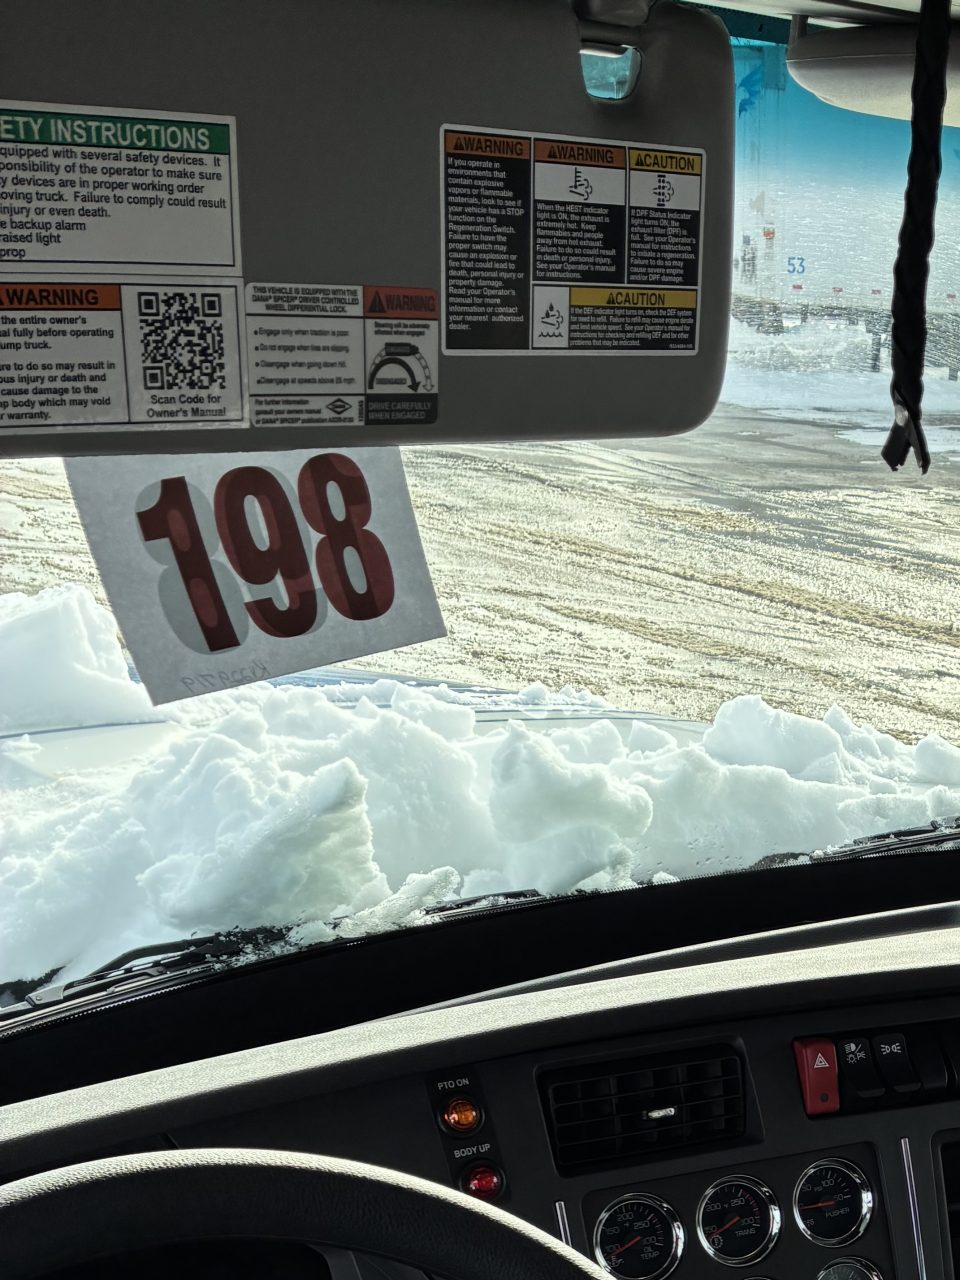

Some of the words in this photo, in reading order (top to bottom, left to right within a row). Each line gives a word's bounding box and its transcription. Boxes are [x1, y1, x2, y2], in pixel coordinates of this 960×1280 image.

[0, 115, 43, 140] ETY
[51, 118, 210, 150] INSTRUCTIONS
[464, 137, 524, 156] WARNING
[0, 145, 49, 160] quipped
[52, 147, 77, 159] with
[81, 149, 122, 161] several
[126, 152, 159, 166] safety
[162, 153, 207, 166] devices.
[213, 156, 221, 166] It
[556, 145, 614, 164] WARNING
[643, 153, 695, 171] CAUTION
[64, 162, 76, 173] of
[79, 163, 97, 175] the
[101, 166, 149, 177] operator
[152, 168, 163, 178] to
[166, 168, 195, 179] make
[199, 171, 222, 181] sure
[11, 175, 56, 187] devices
[58, 178, 76, 188] are
[79, 177, 90, 188] in
[93, 181, 129, 192] proper
[131, 180, 174, 195] working
[176, 183, 205, 193] order
[0, 189, 32, 203] oving
[36, 190, 69, 202] truck.
[74, 191, 110, 203] Failure
[113, 193, 124, 204] to
[126, 194, 164, 208] comply
[167, 196, 195, 207] could
[198, 197, 227, 208] result
[34, 206, 47, 216] or
[49, 207, 75, 217] even
[78, 206, 111, 218] death.
[10, 218, 52, 232] backup
[55, 220, 86, 231] alarm
[35, 232, 62, 246] light
[787, 257, 806, 275] 53
[5, 288, 99, 306] WARNING
[614, 292, 665, 306] CAUTION
[1, 315, 17, 325] the
[19, 315, 47, 325] entire
[50, 315, 87, 325] owner's
[12, 328, 34, 339] fully
[36, 328, 67, 337] before
[70, 328, 114, 339] operating
[24, 341, 52, 350] truck.
[14, 362, 23, 371] to
[26, 362, 39, 371] do
[41, 363, 53, 371] so
[55, 363, 75, 373] may
[78, 361, 105, 370] result
[106, 360, 116, 370] in
[18, 374, 45, 385] injury
[48, 375, 58, 383] or
[60, 373, 87, 383] death
[89, 373, 107, 382] and
[1, 387, 29, 396] cause
[31, 386, 70, 396] damage
[71, 386, 81, 394] to
[83, 385, 98, 394] the
[11, 398, 36, 409] body
[38, 397, 66, 407] which
[69, 398, 89, 408] may
[90, 397, 111, 406] void
[150, 394, 176, 404] Scan
[178, 394, 204, 404] Code
[207, 393, 221, 403] for
[7, 411, 51, 421] warranty.
[147, 408, 188, 418] Owner's
[191, 407, 226, 417] Manual
[136, 453, 395, 653] 198
[437, 1080, 455, 1090] PTO
[456, 1077, 470, 1087] ON
[453, 1145, 477, 1158] BODY
[478, 1143, 491, 1153] UP
